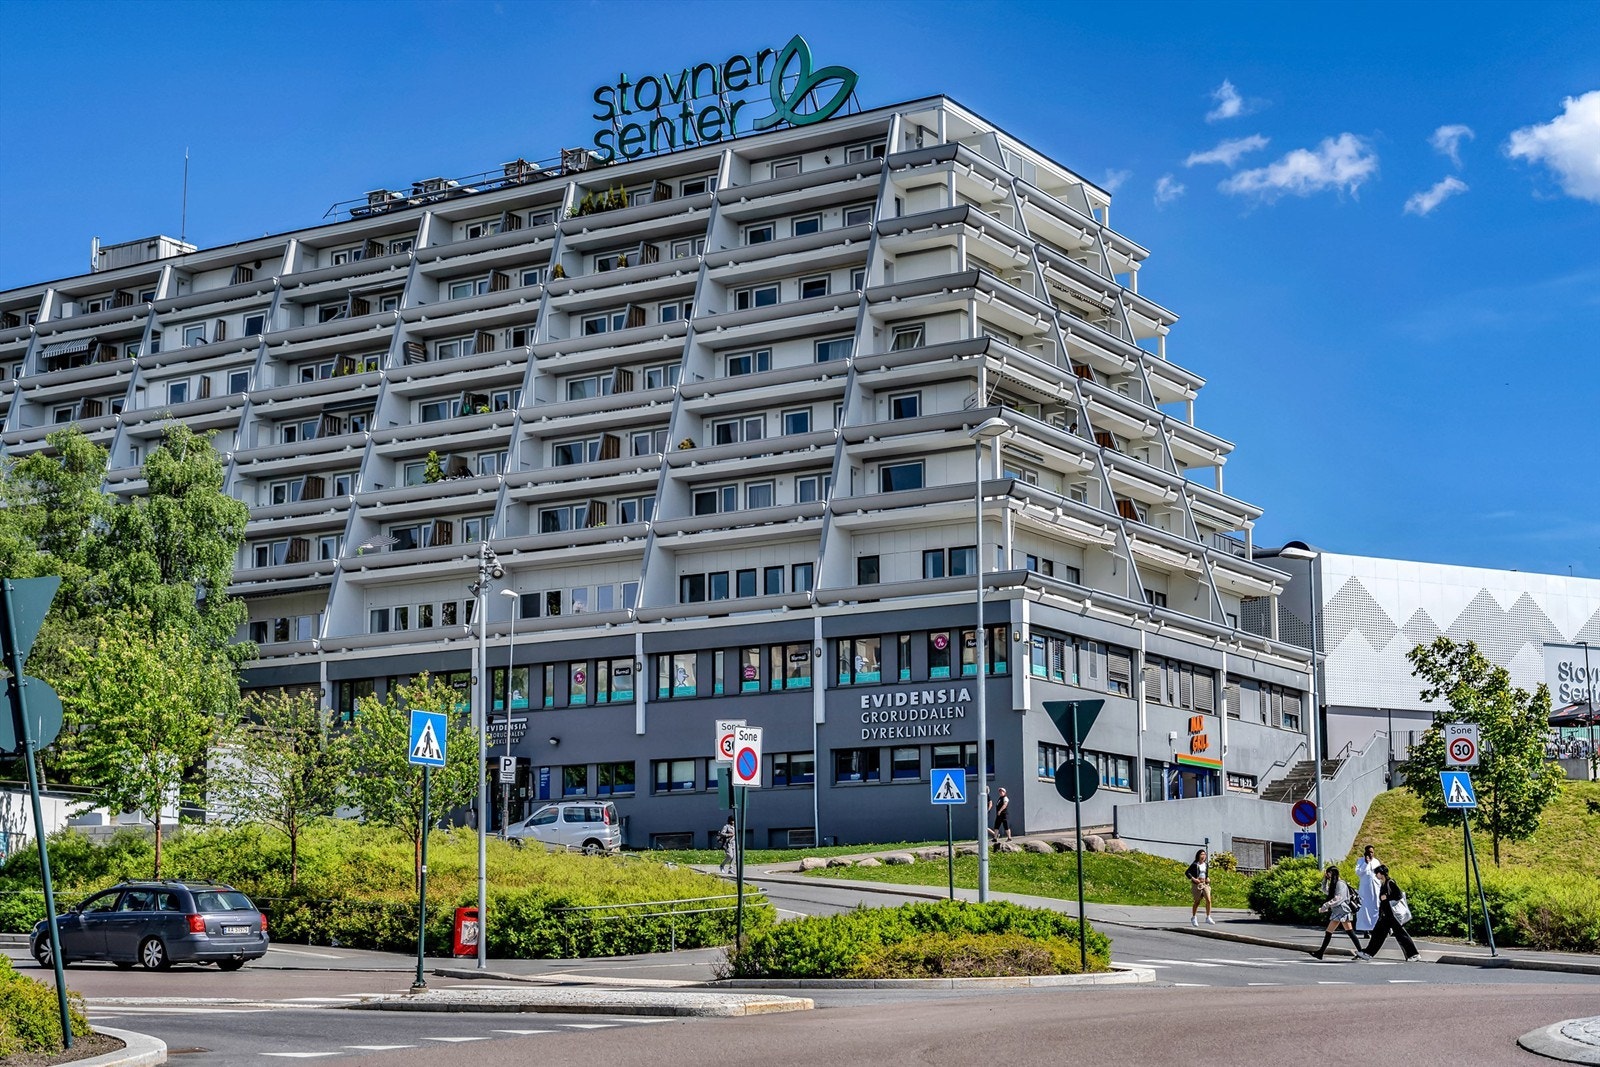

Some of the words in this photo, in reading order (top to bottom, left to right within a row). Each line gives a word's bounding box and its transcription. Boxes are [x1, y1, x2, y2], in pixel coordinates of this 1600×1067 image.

[593, 48, 775, 121] stovner
[593, 99, 747, 164] senter
[861, 688, 971, 709] EVIDENSIA
[861, 706, 965, 724] GRORUDDALEN
[721, 722, 740, 731] Son
[861, 723, 951, 740] DYREKLINIKK
[1450, 726, 1472, 735] Sone
[738, 730, 758, 741] Sone
[1454, 744, 1470, 756] 30
[503, 758, 512, 771] P
